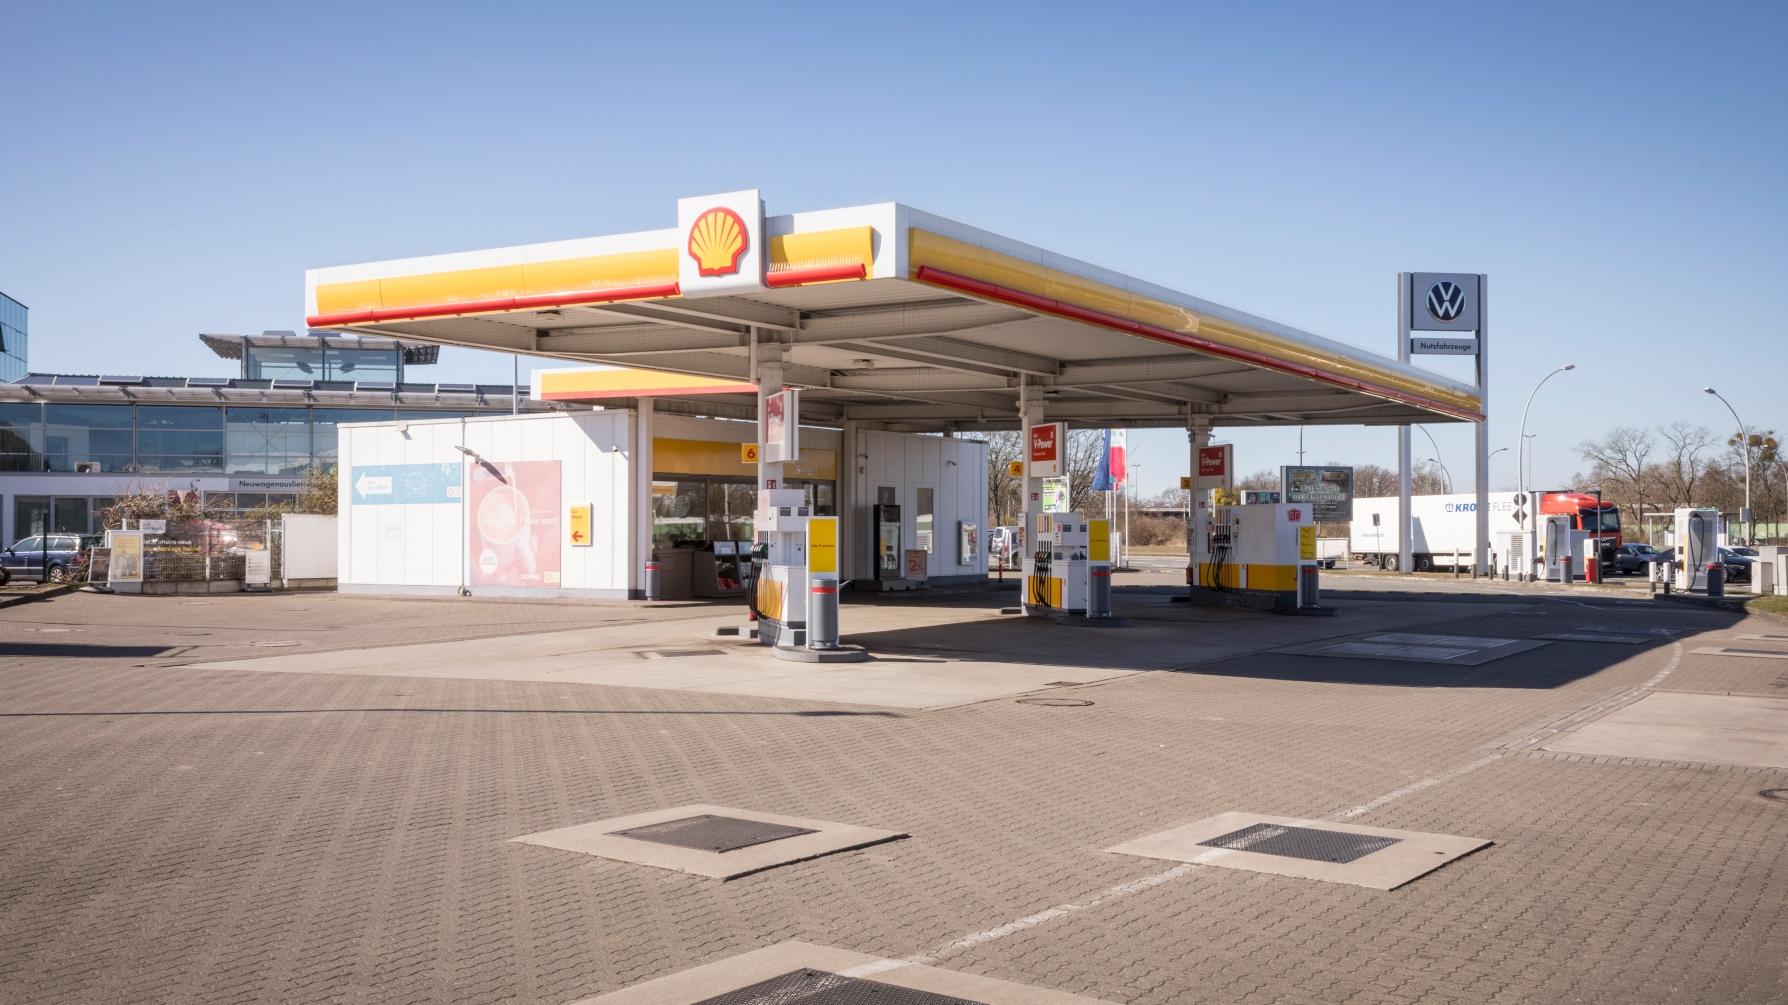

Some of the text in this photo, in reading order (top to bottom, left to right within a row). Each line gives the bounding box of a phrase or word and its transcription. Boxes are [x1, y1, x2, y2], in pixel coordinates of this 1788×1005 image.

[1428, 281, 1465, 321] VW
[1420, 342, 1472, 352] Nutzfahrzeuge
[1033, 439, 1054, 450] V-Power
[747, 448, 755, 459] 6
[1201, 457, 1222, 467] V-Power
[1455, 503, 1491, 512] KROE
